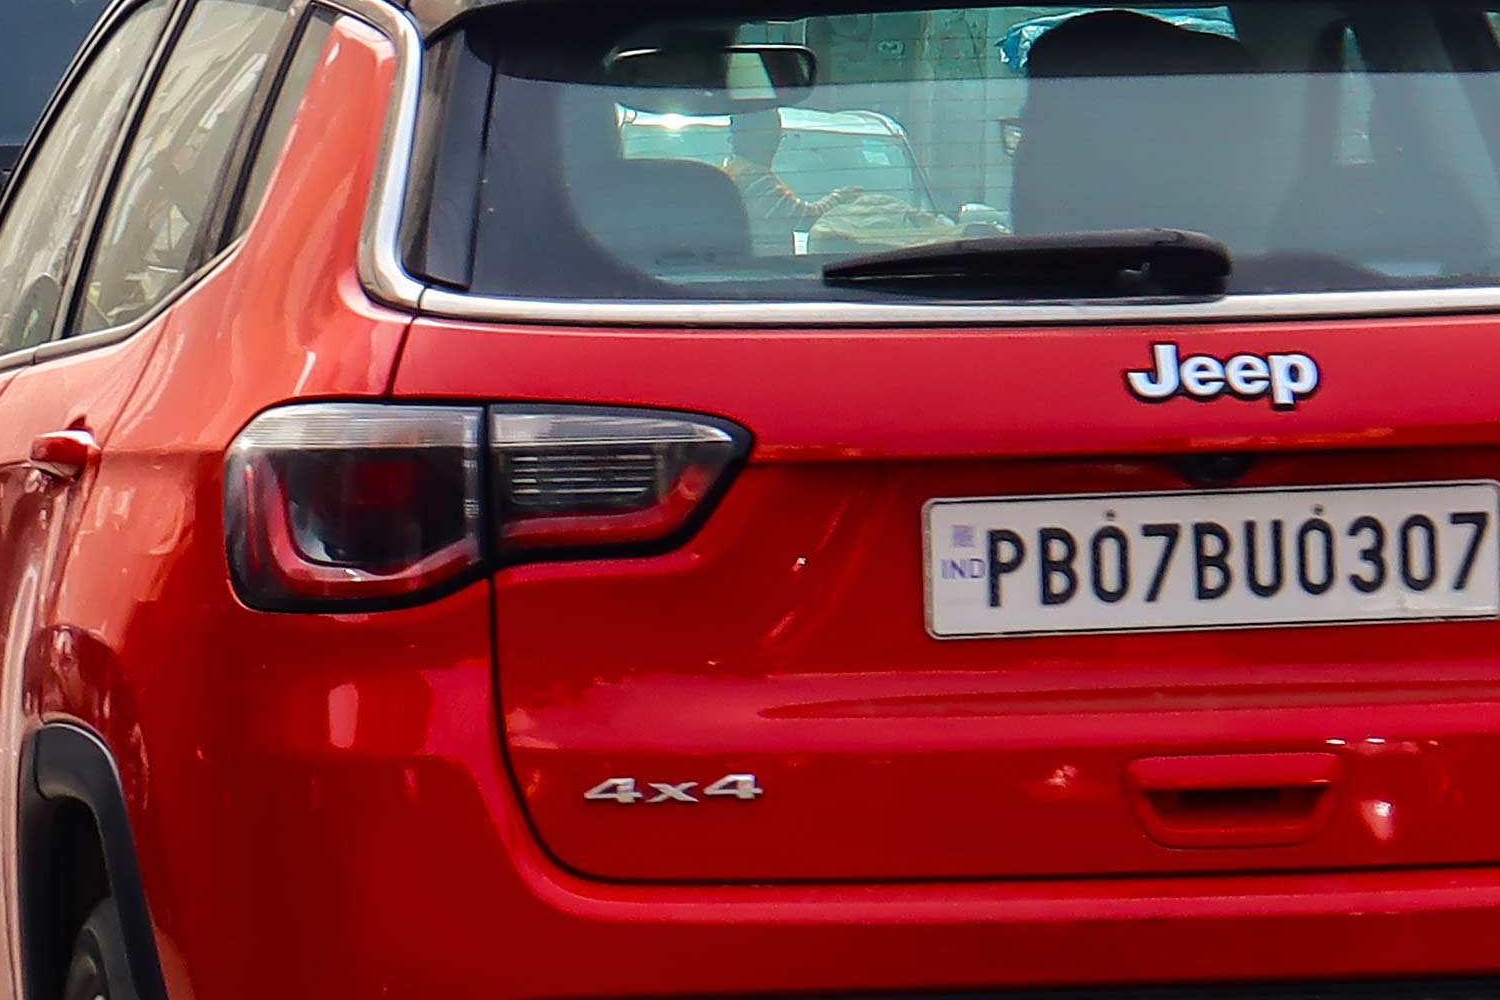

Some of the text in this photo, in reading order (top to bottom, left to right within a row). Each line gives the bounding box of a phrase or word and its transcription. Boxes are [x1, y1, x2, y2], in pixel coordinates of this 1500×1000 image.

[1125, 342, 1320, 408] Jeep
[941, 558, 985, 580] IND
[987, 512, 1490, 608] PB07BU0307
[583, 773, 764, 804] 4x4
